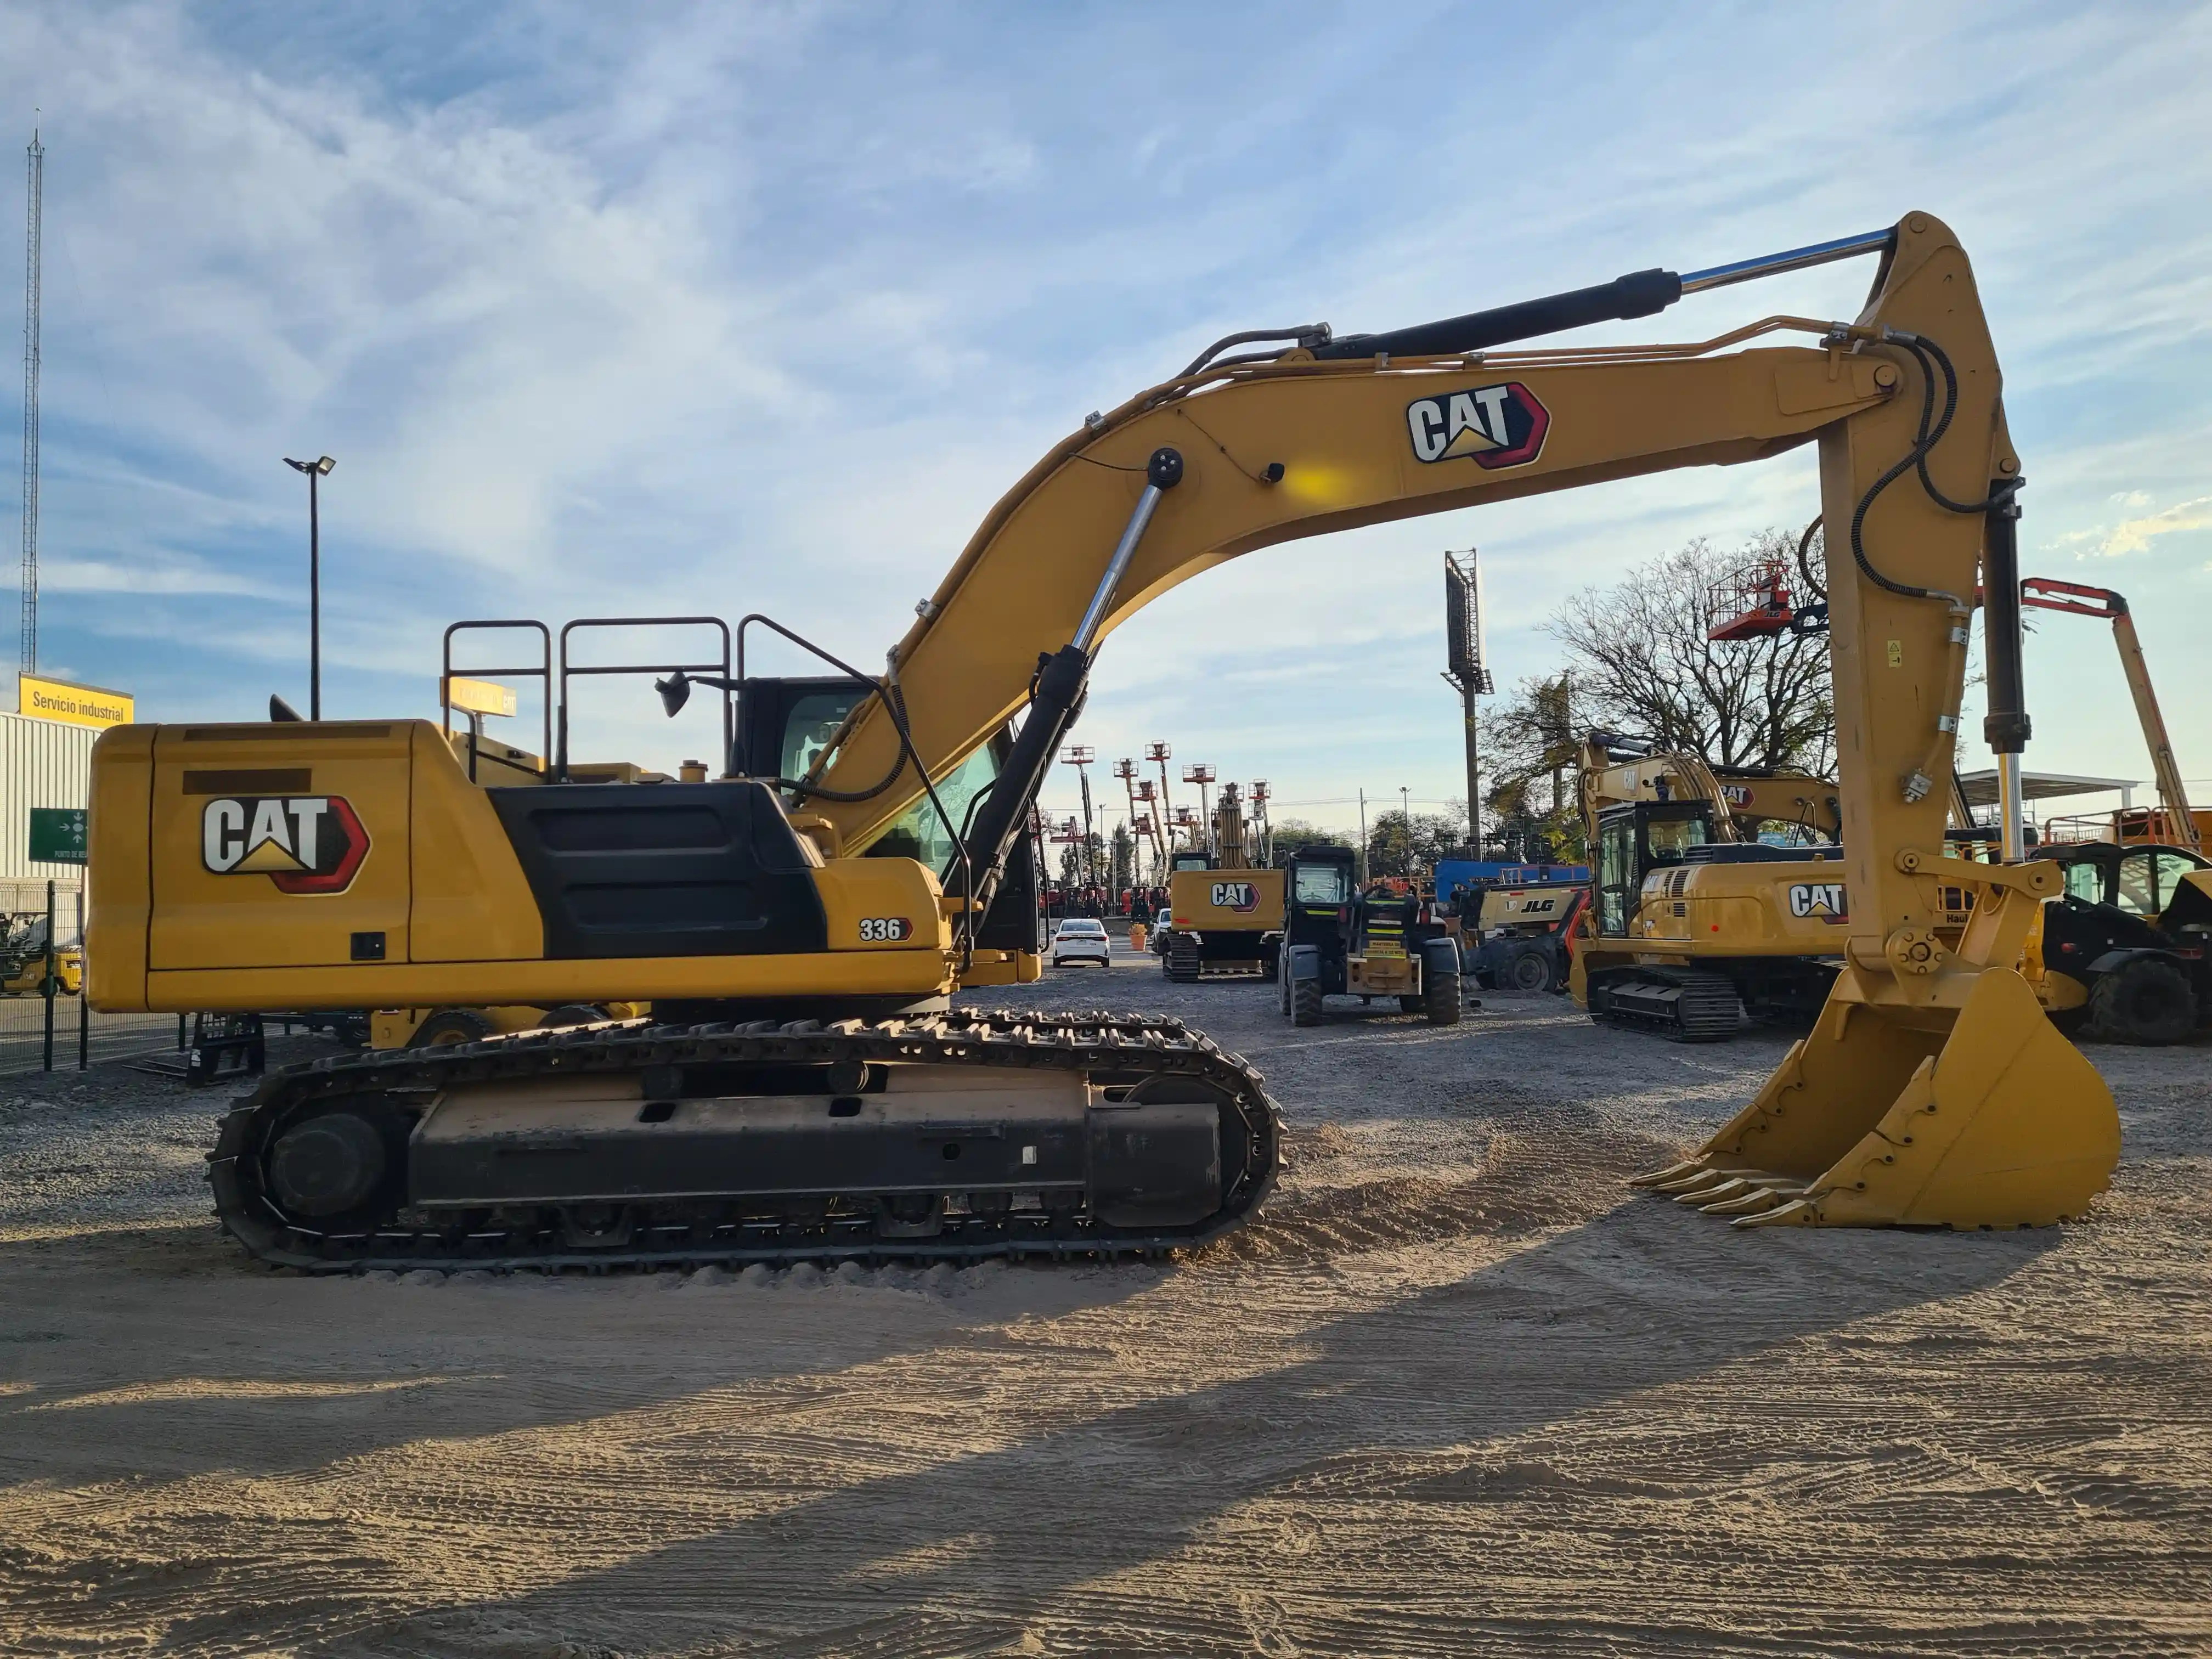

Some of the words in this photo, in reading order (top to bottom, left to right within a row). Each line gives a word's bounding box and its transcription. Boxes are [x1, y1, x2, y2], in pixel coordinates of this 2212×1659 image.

[1408, 386, 1509, 461] CAT
[33, 691, 76, 713] Servicio
[79, 699, 123, 722] industrial
[1624, 771, 1635, 790] CAT
[204, 799, 328, 872] CAT
[1212, 884, 1248, 905] CAT
[1521, 900, 1555, 913] JLG
[1791, 885, 1842, 916] CAT
[860, 919, 900, 940] 336
